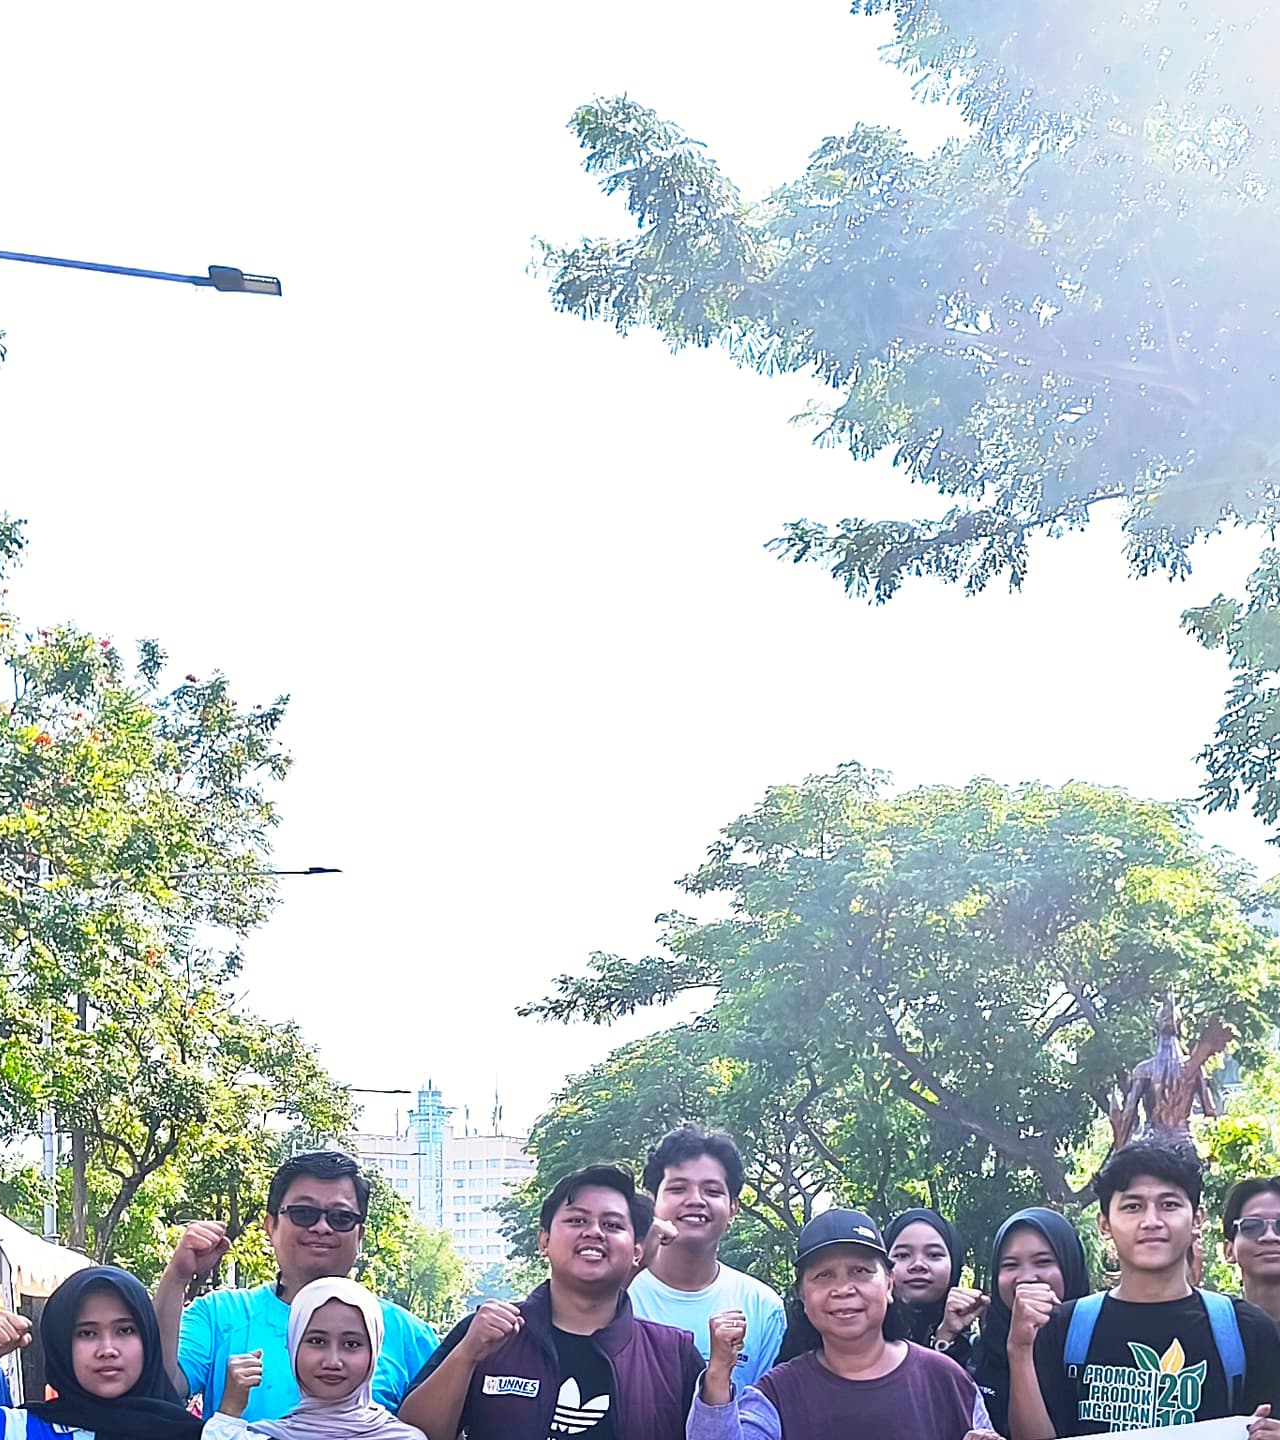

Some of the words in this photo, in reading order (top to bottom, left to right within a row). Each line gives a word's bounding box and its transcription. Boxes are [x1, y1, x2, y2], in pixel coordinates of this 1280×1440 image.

[498, 1379, 538, 1392] UNNES
[1083, 1365, 1152, 1387] PROMOSI
[1090, 1384, 1152, 1405] PRODUK
[1159, 1373, 1201, 1410] 20
